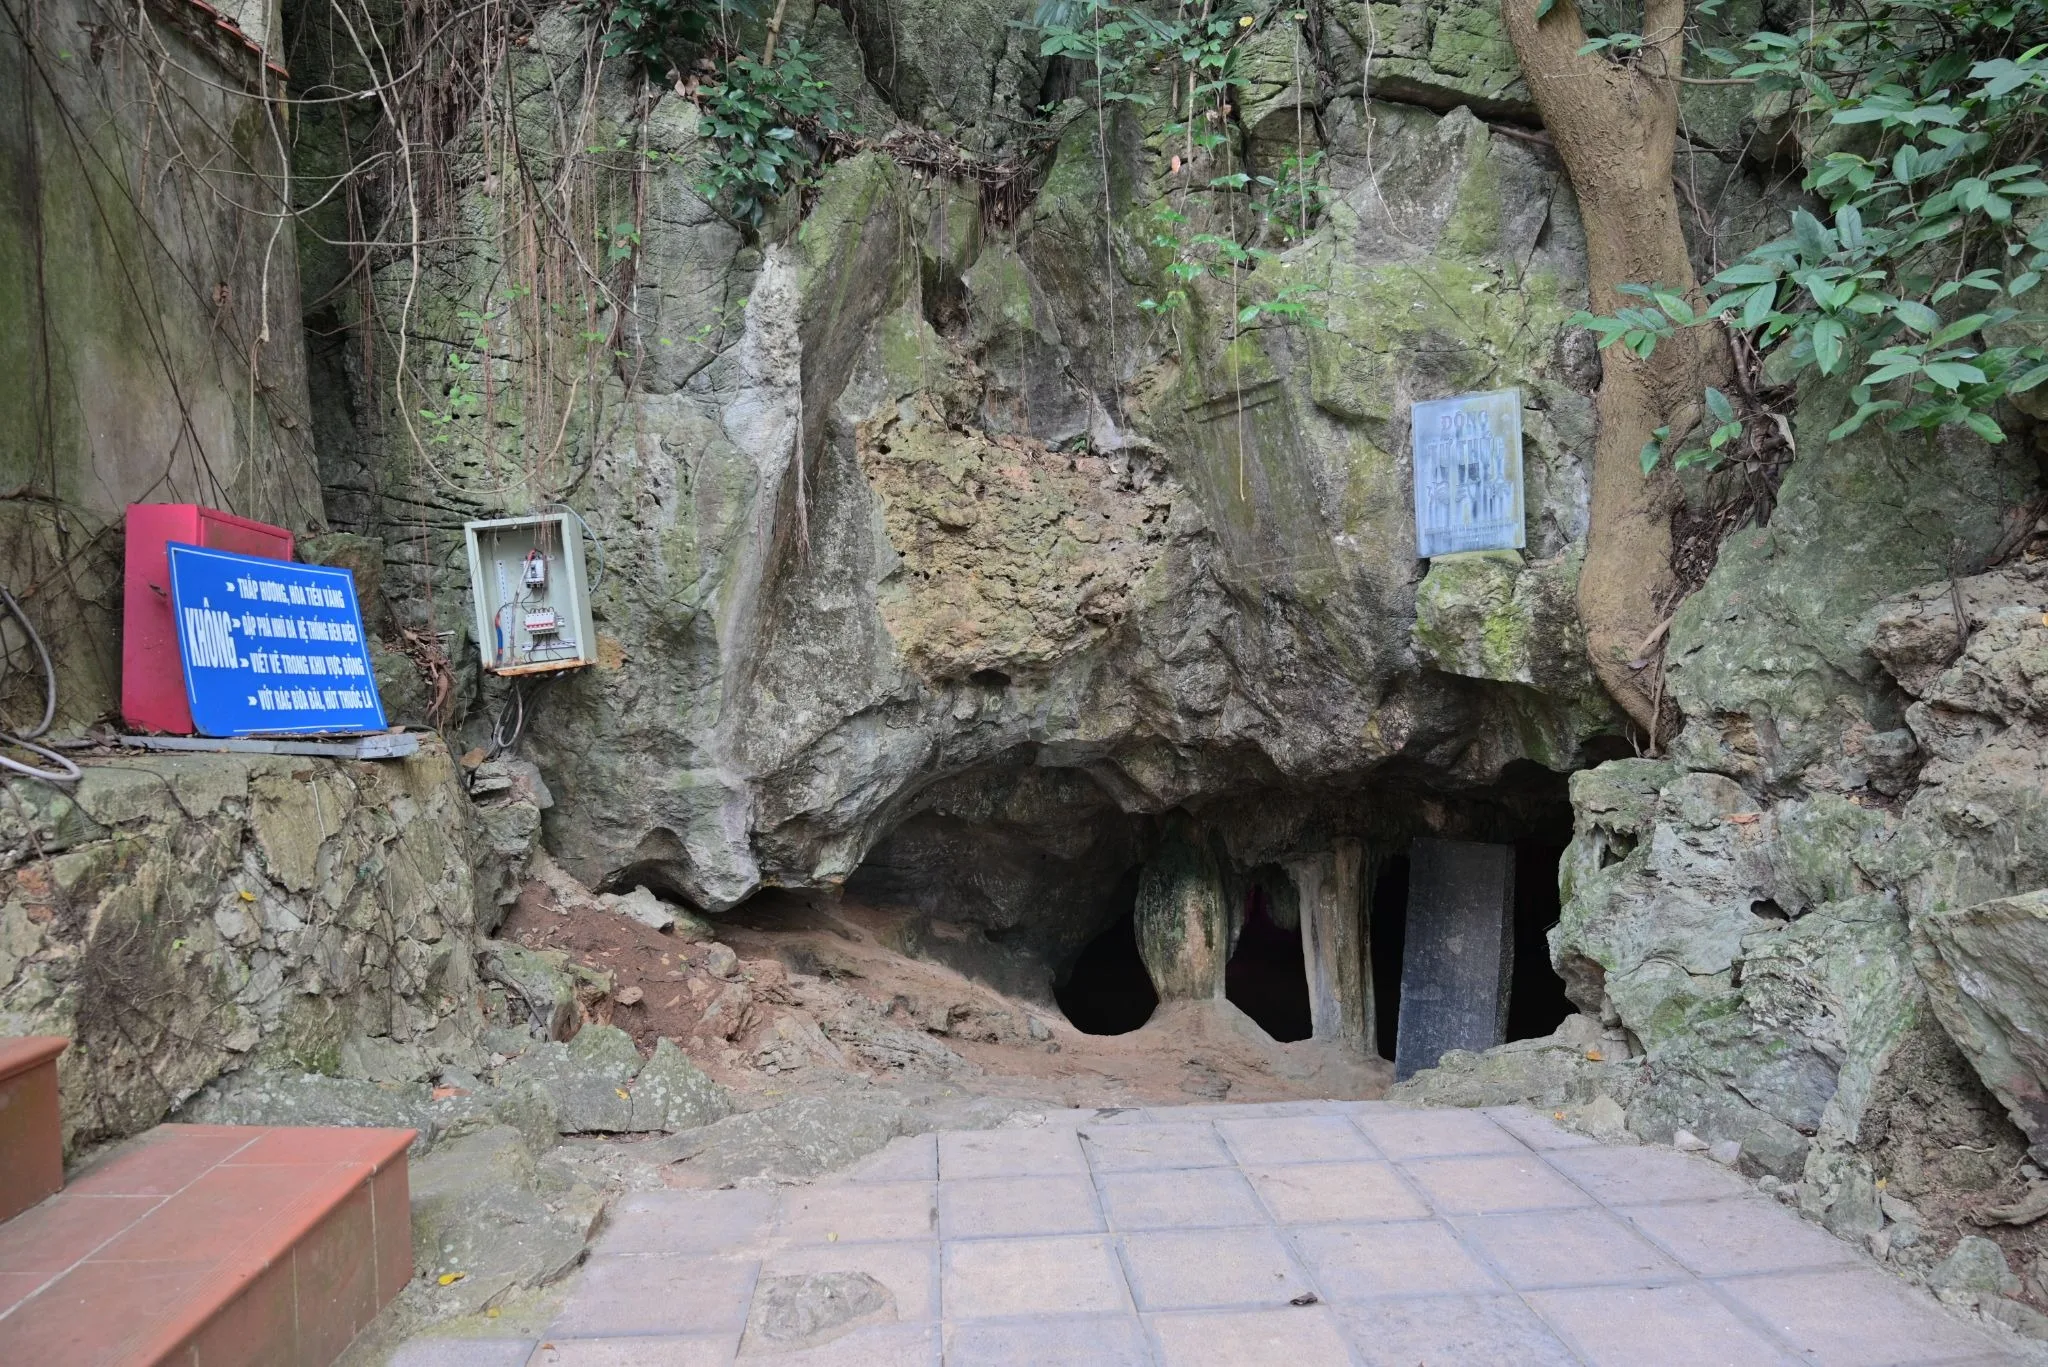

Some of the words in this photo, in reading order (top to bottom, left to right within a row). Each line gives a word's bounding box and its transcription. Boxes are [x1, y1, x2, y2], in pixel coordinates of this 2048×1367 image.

[289, 581, 307, 605] HÓA
[322, 585, 346, 608] VÀNG
[184, 597, 239, 669] KHÔNG
[256, 612, 273, 637] PHÁ
[306, 614, 330, 641] THỐNG
[341, 620, 358, 646] ĐIỆN
[249, 646, 270, 673] VIẾT
[281, 653, 310, 675] TRONG
[308, 655, 327, 675] KHU
[325, 654, 343, 679] VỰC
[341, 653, 366, 679] ĐỘNG
[257, 684, 275, 710] VỨT
[274, 685, 292, 710] RÁC
[290, 685, 310, 710] BỪA
[323, 686, 340, 710] HÚT
[338, 684, 363, 709] THUỐC
[361, 686, 374, 709] LÁ
